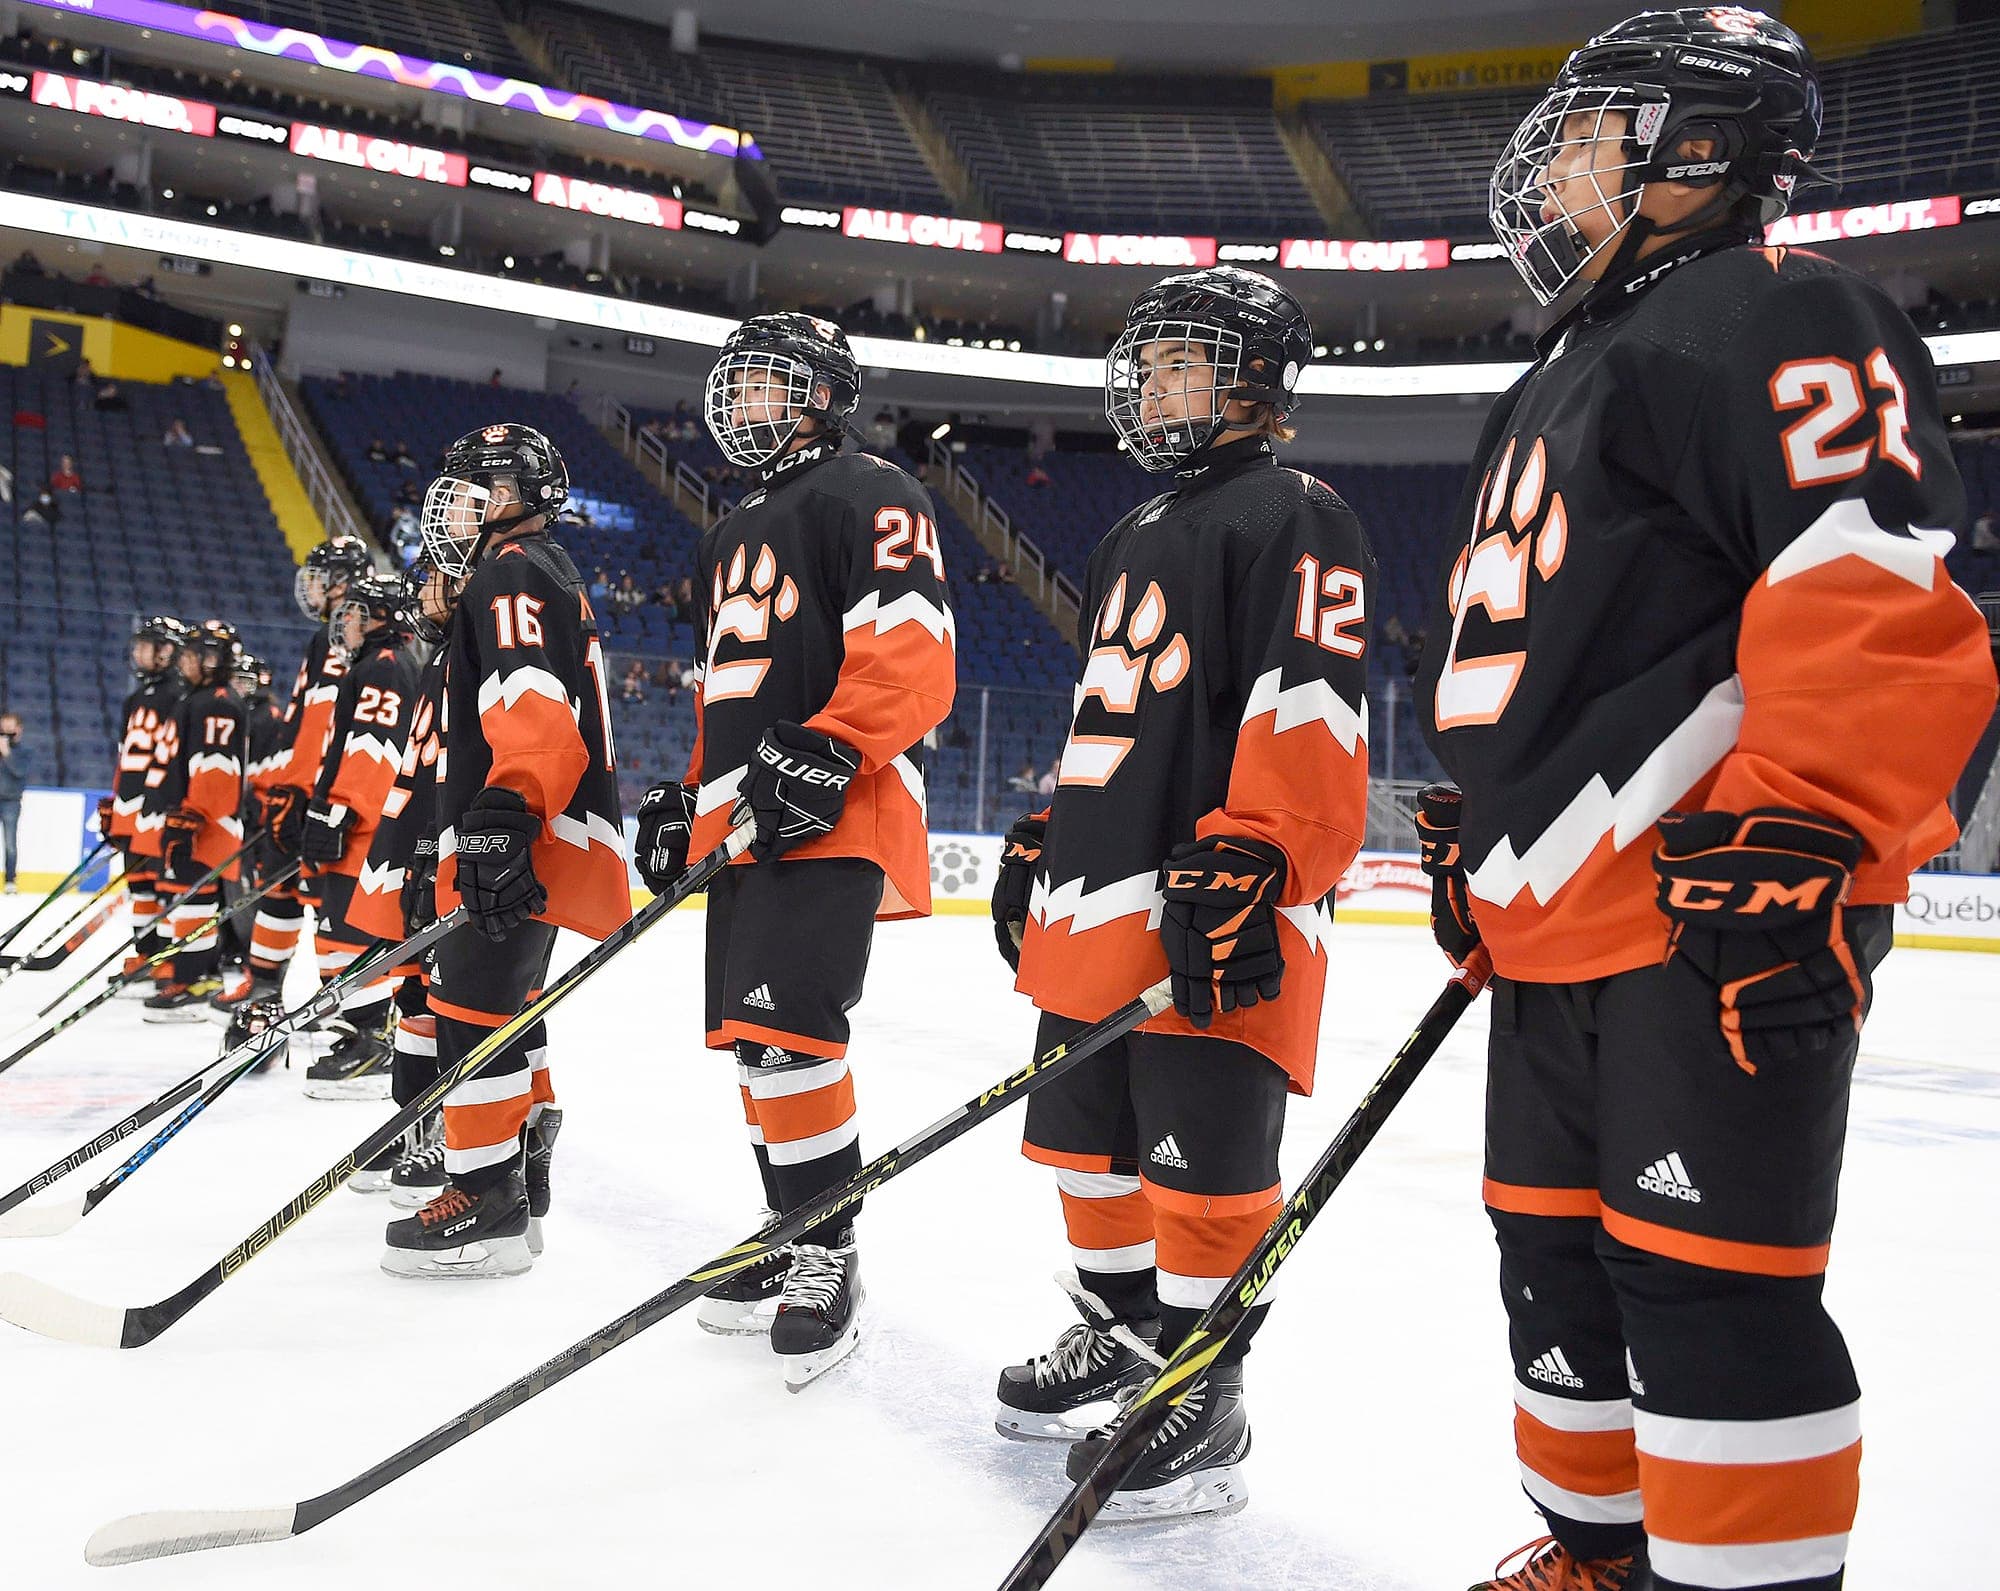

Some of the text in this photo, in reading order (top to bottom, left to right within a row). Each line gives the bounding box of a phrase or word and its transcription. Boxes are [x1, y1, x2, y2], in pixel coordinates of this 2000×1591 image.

[1680, 55, 1752, 79] BAUER
[1665, 161, 1731, 182] CCM
[848, 207, 910, 244] ALL
[1765, 199, 1937, 247] ALL OUT.
[1237, 311, 1269, 326] CCM
[481, 458, 513, 467] CCM
[873, 505, 946, 582] 24
[490, 592, 546, 650] 16
[1293, 551, 1367, 660] 12
[353, 683, 402, 728] 23
[205, 716, 236, 746] 17
[1903, 891, 2000, 925] Québ
[742, 996, 776, 1011] adidas
[760, 1054, 793, 1068] adidas
[27, 1115, 140, 1198] BAUER
[1149, 1151, 1190, 1171] adidas
[803, 1176, 883, 1232] SUPER
[1636, 1174, 1702, 1204] adidas
[221, 1150, 360, 1283] BAUER
[443, 1216, 478, 1238] CCM
[1239, 1218, 1304, 1308] SUPER
[760, 1271, 788, 1290] CC
[1527, 1365, 1585, 1390] adidas
[1169, 1438, 1211, 1472] CCM
